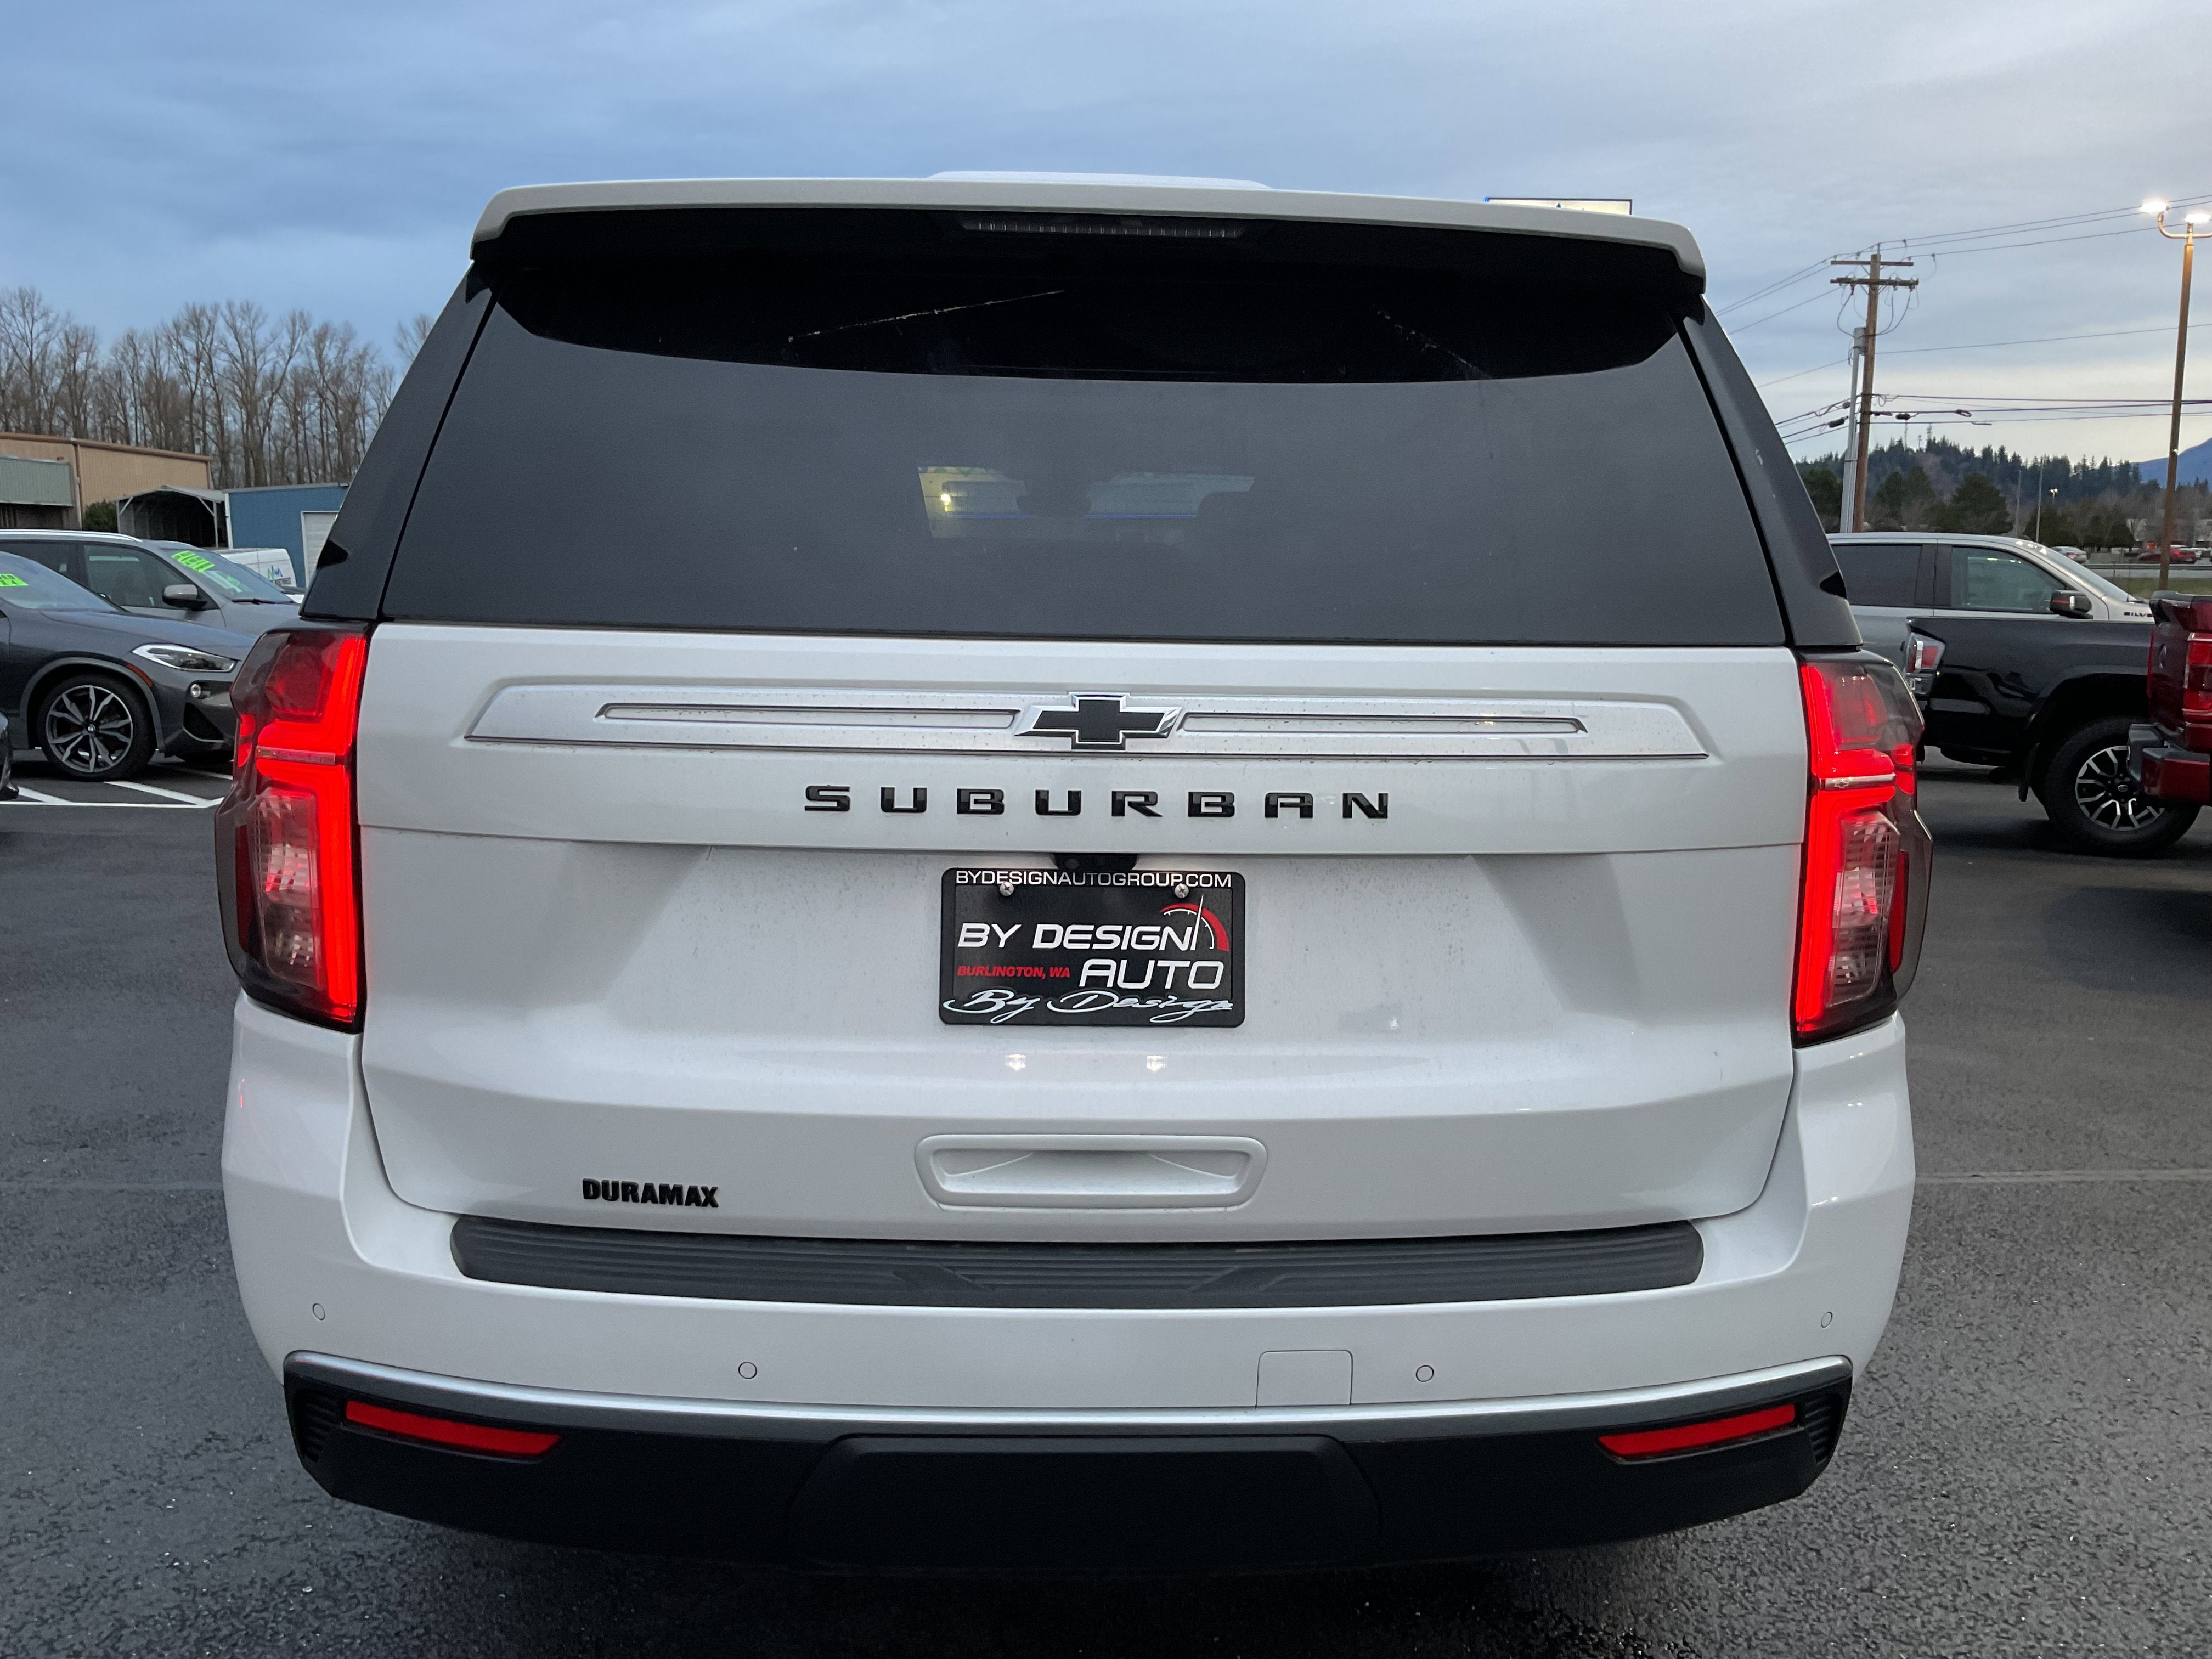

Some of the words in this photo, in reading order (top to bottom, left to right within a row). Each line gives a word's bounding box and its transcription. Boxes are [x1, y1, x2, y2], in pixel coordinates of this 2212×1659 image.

[804, 786, 1388, 819] SUBURBAN
[956, 871, 1231, 887] BYDESIGNAUTOGROUP.COM
[958, 923, 1022, 948] BY
[1032, 924, 1192, 951] DESIGN
[957, 966, 1046, 980] BURLINGTON,
[1049, 967, 1070, 978] WA
[1079, 959, 1224, 989] AUTO
[943, 990, 1040, 1024] By
[1047, 991, 1234, 1023] Design
[582, 1178, 719, 1208] DURAMAX
